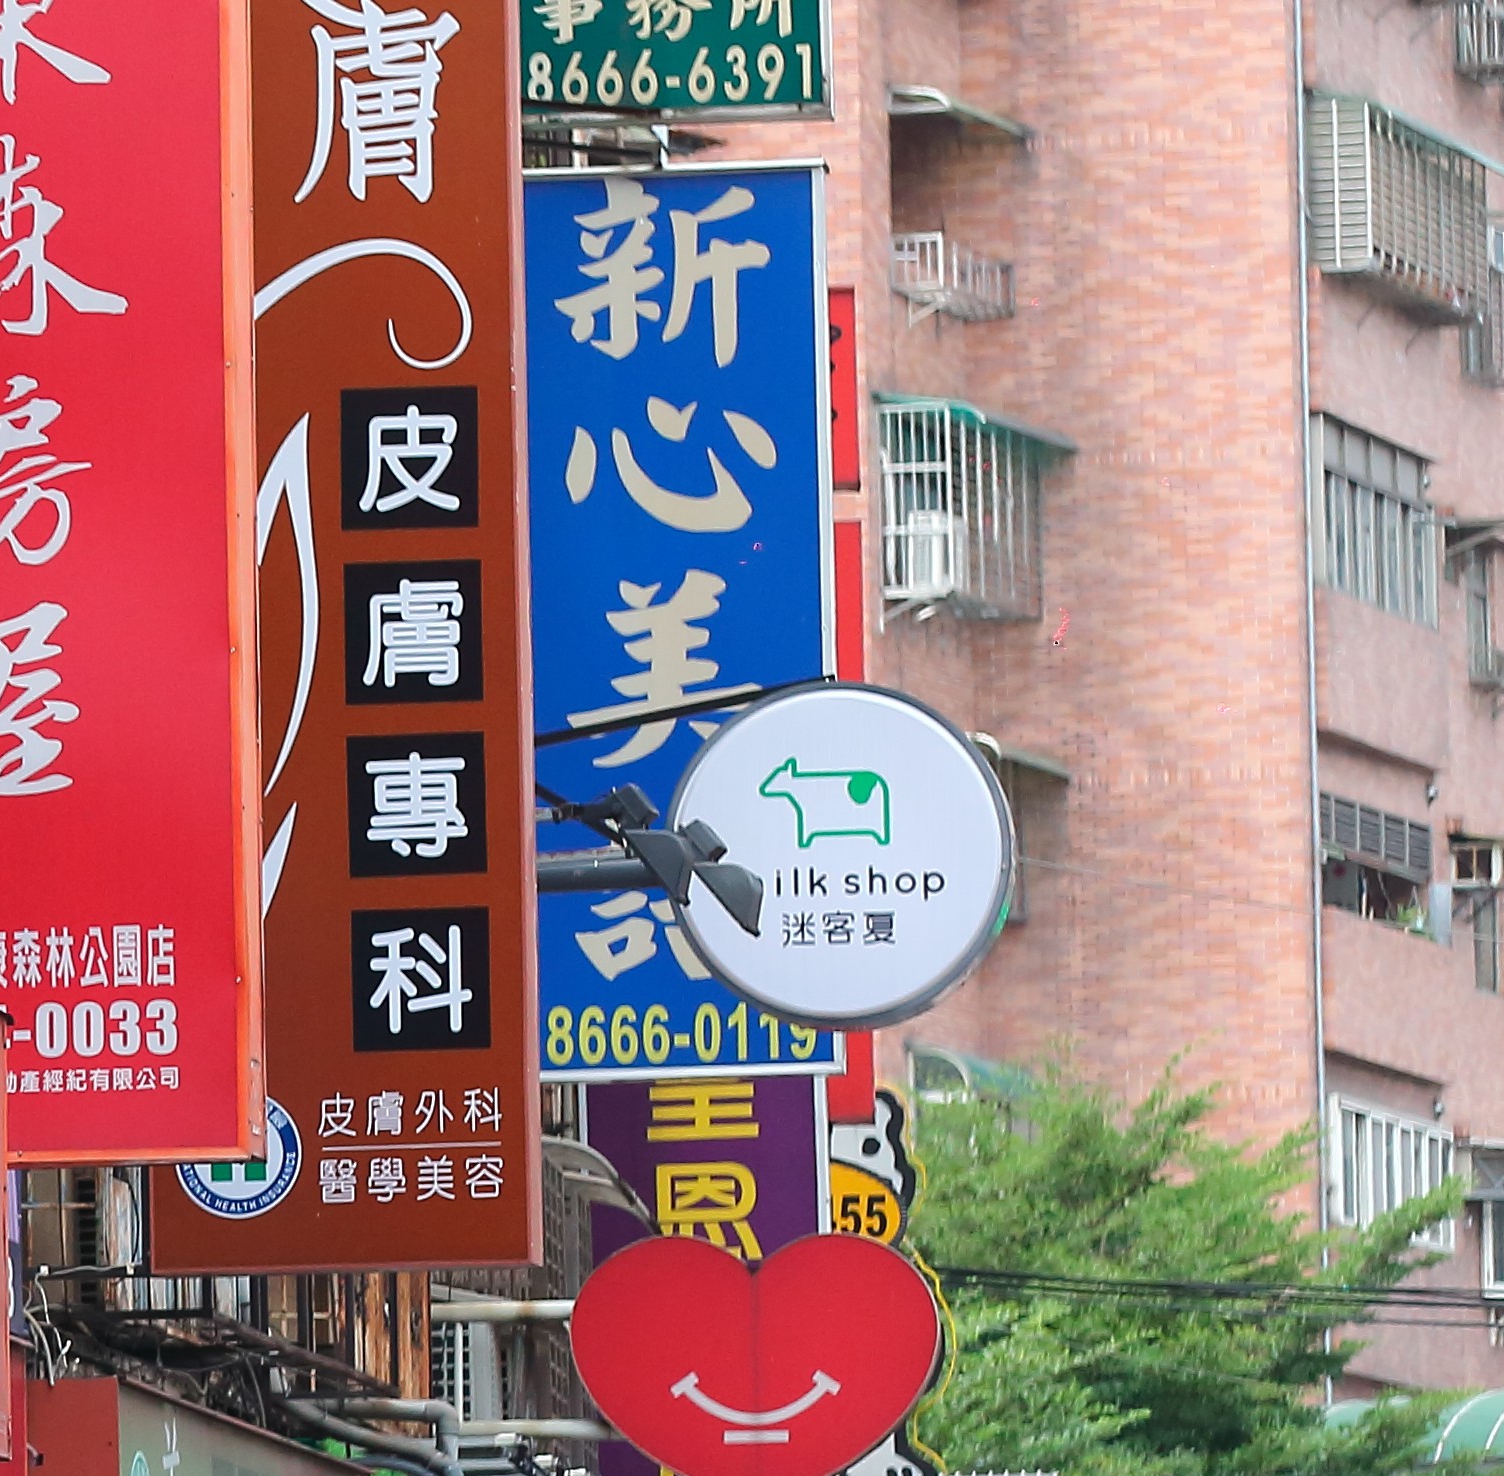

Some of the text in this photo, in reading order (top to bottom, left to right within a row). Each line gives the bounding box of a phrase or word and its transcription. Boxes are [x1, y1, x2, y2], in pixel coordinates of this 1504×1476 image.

[527, 44, 812, 104] 8666-6391
[553, 177, 779, 981] 新心美
[358, 404, 473, 1036] 皮膚專科
[774, 864, 945, 902] ilk shop
[781, 910, 897, 947] 迷客夏
[546, 1002, 818, 1067] 8666-0119
[318, 1086, 503, 1138] 皮膚外科
[183, 1164, 211, 1204] ATIONAL
[214, 1199, 257, 1214] HEALTH
[318, 1154, 504, 1204] 醫學美容
[831, 1194, 888, 1239] 55
